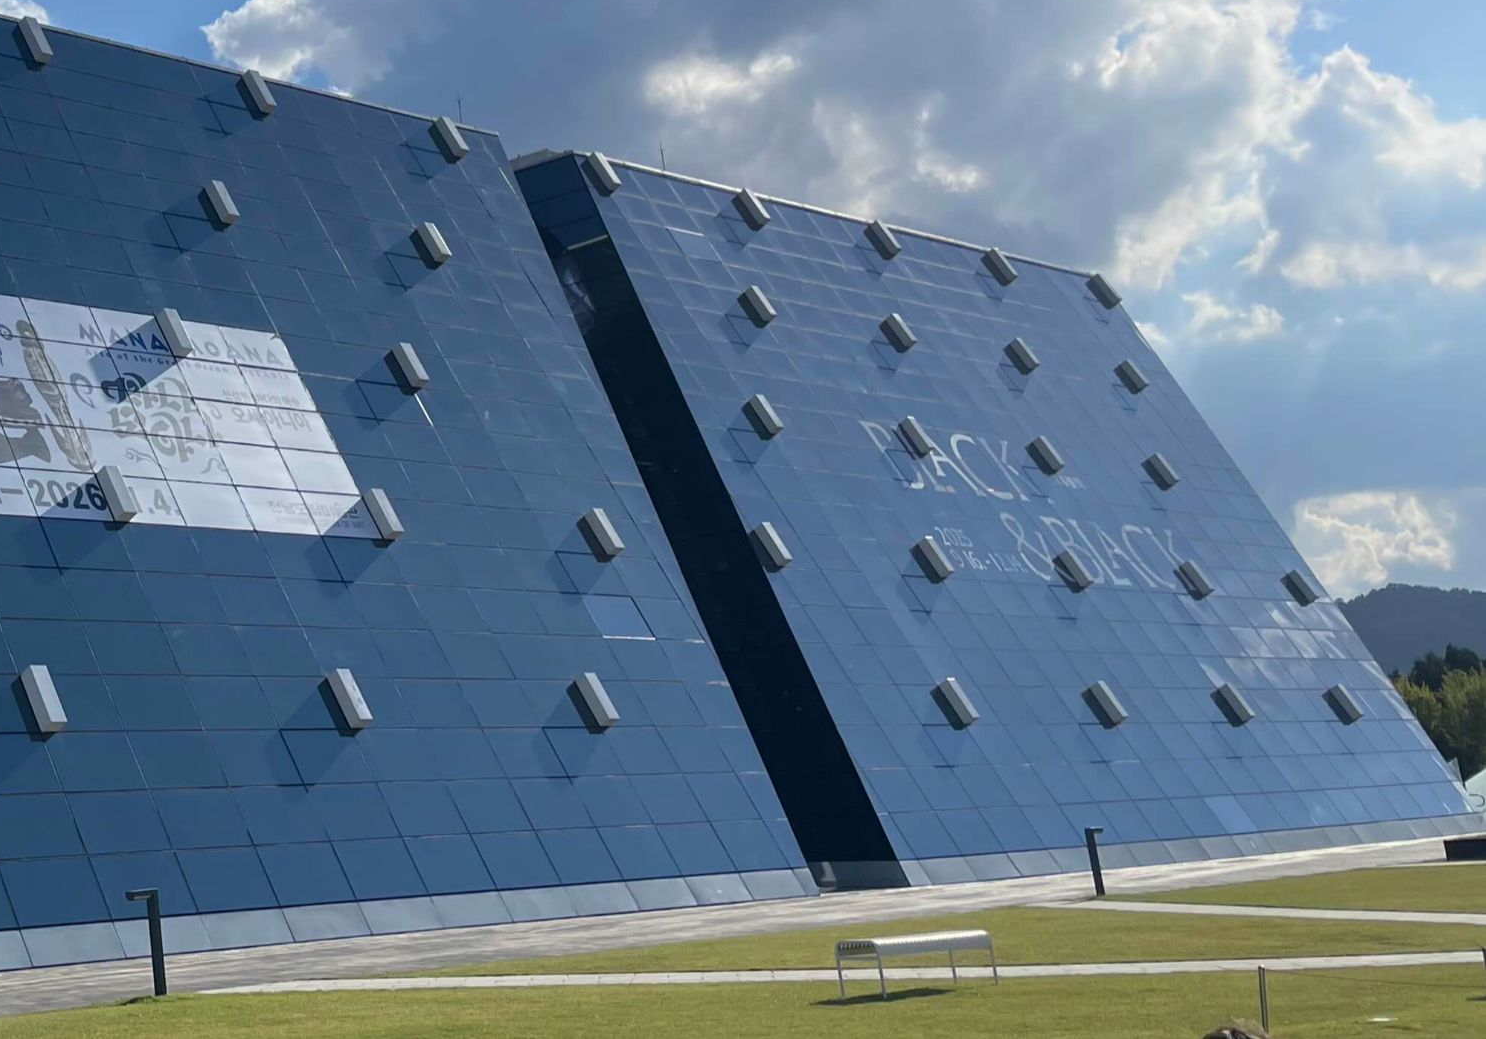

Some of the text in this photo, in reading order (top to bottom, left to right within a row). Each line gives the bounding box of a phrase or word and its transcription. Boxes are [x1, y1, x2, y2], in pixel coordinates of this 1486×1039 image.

[79, 322, 170, 353] MANA
[116, 353, 129, 361] of
[134, 352, 153, 364] the
[231, 407, 313, 433] 오세아니아
[934, 526, 973, 548] 2025
